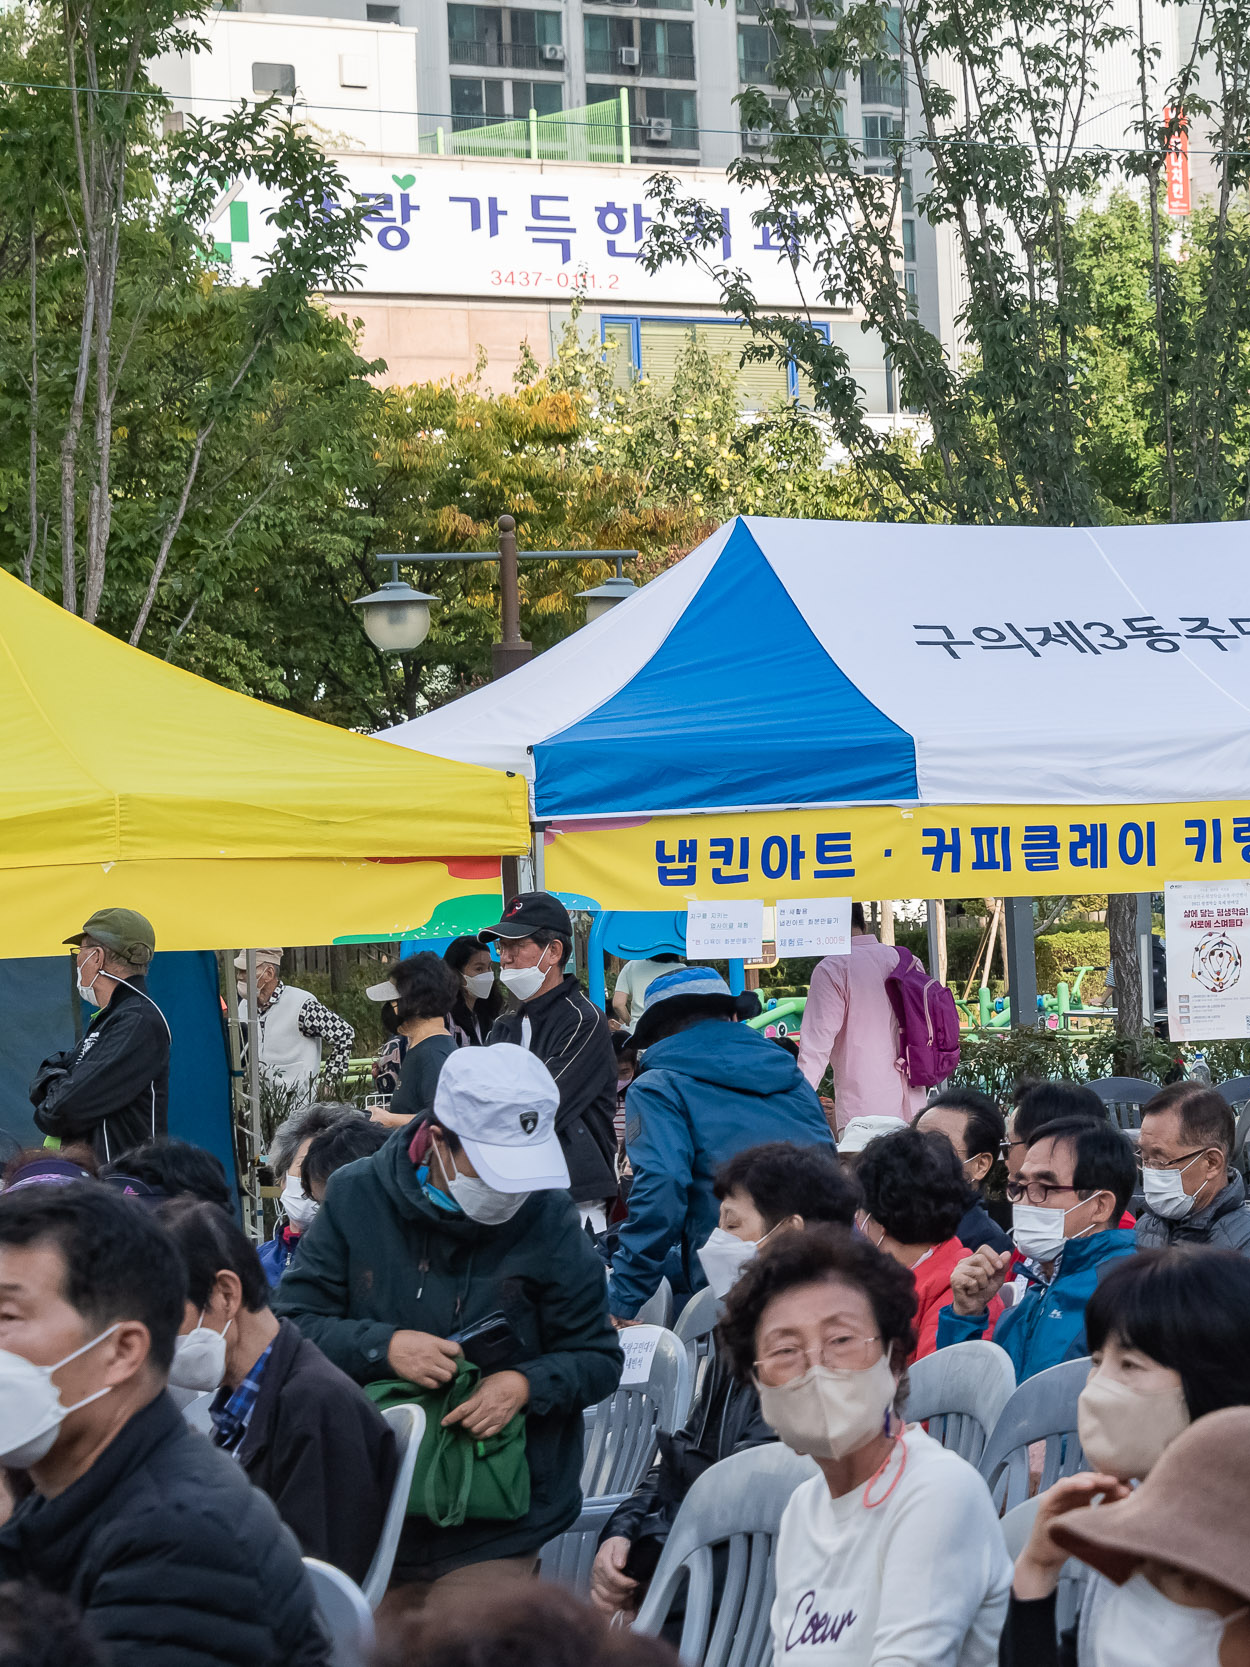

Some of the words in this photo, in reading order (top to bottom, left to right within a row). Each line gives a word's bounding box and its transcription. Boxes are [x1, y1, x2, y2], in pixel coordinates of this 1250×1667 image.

[449, 195, 653, 265] 가득한
[655, 832, 856, 886] 냅킨아트
[922, 821, 1156, 873] 커피클레이
[710, 912, 729, 920] 지키는
[1183, 909, 1198, 919] 삶에
[1216, 907, 1249, 917] 평생학습!
[1190, 919, 1212, 929] 서로에
[1213, 918, 1244, 928] 스며들다
[785, 1589, 858, 1652] Coeur
